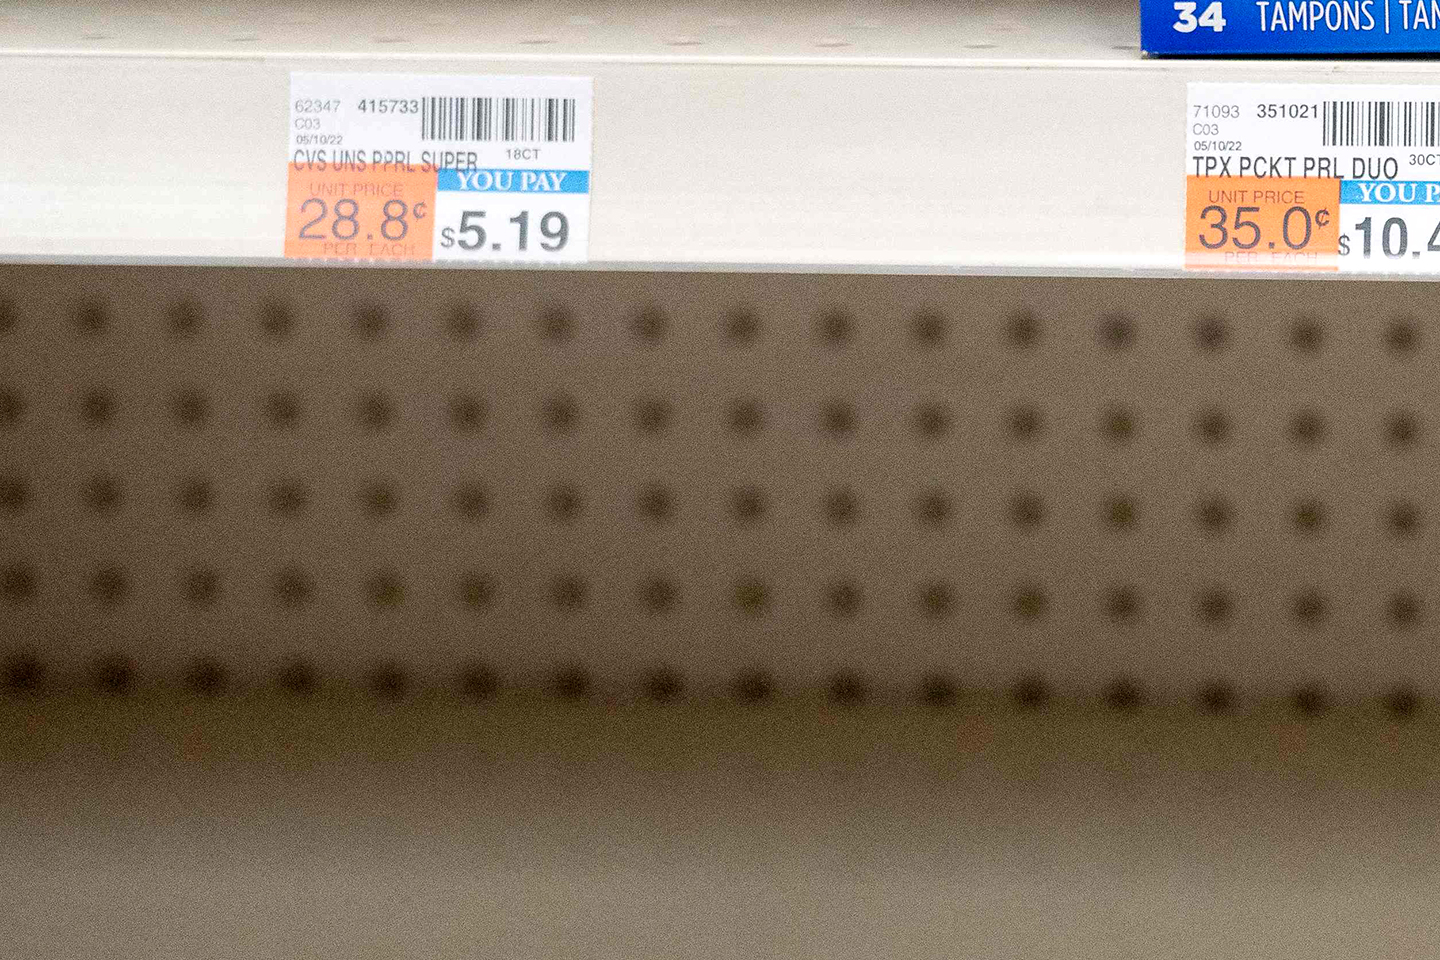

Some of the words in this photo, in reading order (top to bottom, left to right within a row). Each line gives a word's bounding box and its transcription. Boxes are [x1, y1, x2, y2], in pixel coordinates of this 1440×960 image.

[1173, 2, 1226, 32] 34
[1256, 0, 1375, 32] TAMPONS
[295, 100, 341, 113] 62347
[357, 100, 419, 113] 415733
[1193, 105, 1240, 119] 71093
[1257, 104, 1318, 119] 351021
[295, 118, 321, 130] C03
[1193, 123, 1219, 136] C03
[296, 135, 343, 146] 05/10/22
[1194, 140, 1242, 152] 05/10/22
[293, 150, 327, 172] CVS
[332, 150, 366, 172] UNS
[421, 151, 478, 172] SUPER
[506, 148, 541, 160] 18CT
[1193, 156, 1231, 178] TPX
[1239, 156, 1296, 179] PCKT
[1303, 157, 1344, 179] PRL
[1352, 157, 1399, 180] DUO
[456, 171, 513, 191] YOU
[521, 172, 568, 191] PAY
[309, 182, 348, 196] UNIT
[353, 183, 403, 197] PRICE
[1209, 190, 1248, 203] UNIT
[1254, 191, 1305, 204] PRICE
[1358, 183, 1416, 202] YOU
[440, 210, 570, 252] $5.19
[323, 243, 357, 255] PER
[369, 243, 415, 256] EACH
